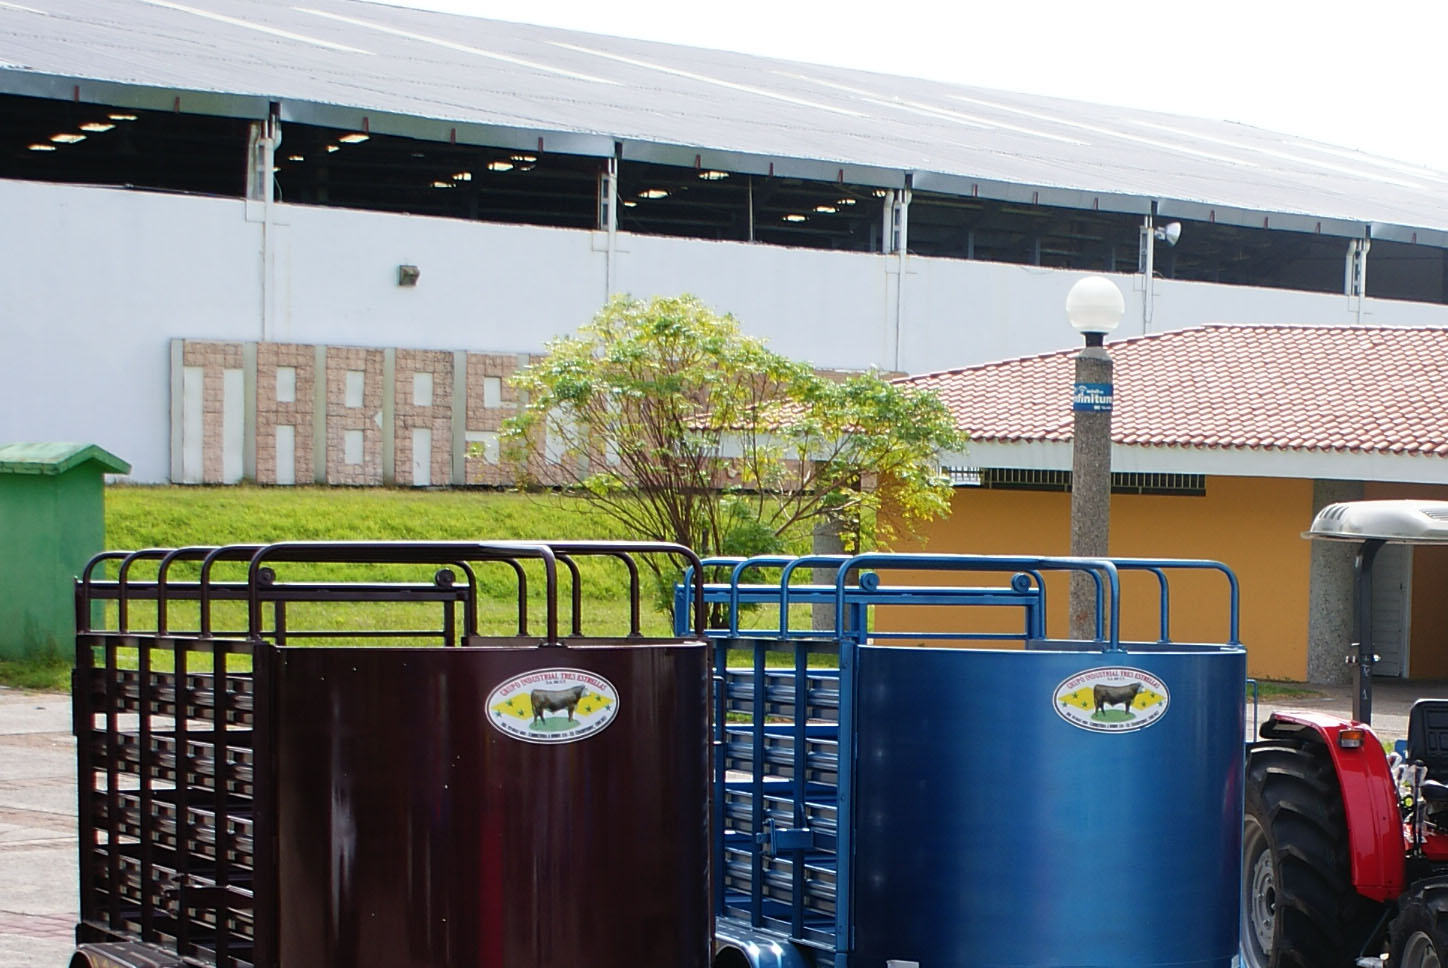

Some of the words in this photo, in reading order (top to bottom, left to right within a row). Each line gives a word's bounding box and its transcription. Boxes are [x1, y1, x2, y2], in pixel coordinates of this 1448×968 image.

[1074, 391, 1113, 404] nfinitum
[500, 681, 521, 696] GRUPO
[522, 673, 559, 686] INDUSTRIAL
[577, 674, 607, 691] ESTRELLAS
